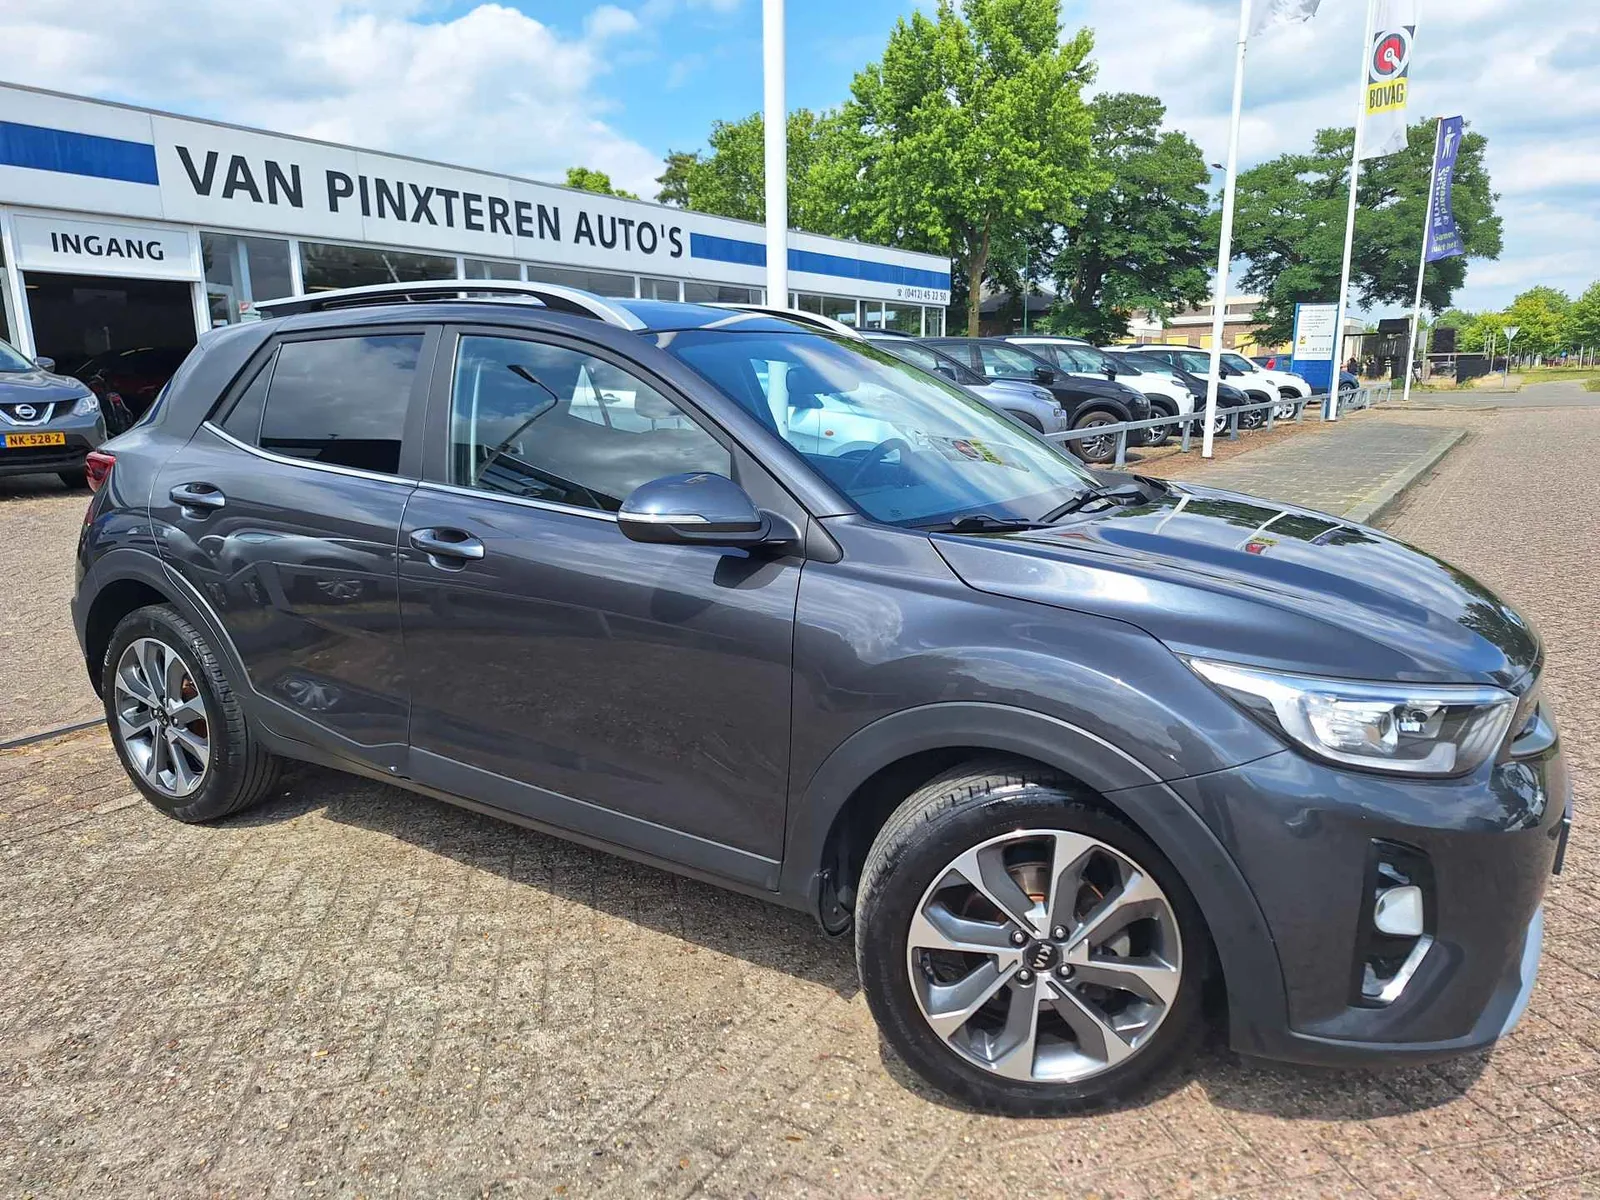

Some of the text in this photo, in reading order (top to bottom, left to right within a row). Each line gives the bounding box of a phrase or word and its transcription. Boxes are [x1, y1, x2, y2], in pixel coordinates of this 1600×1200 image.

[1369, 83, 1404, 109] BOVAG
[174, 145, 683, 258] VAN PINXTEREN AUTO'S
[50, 232, 164, 261] INGANG
[924, 290, 931, 300] 45
[9, 433, 62, 446] NK-528-Z
